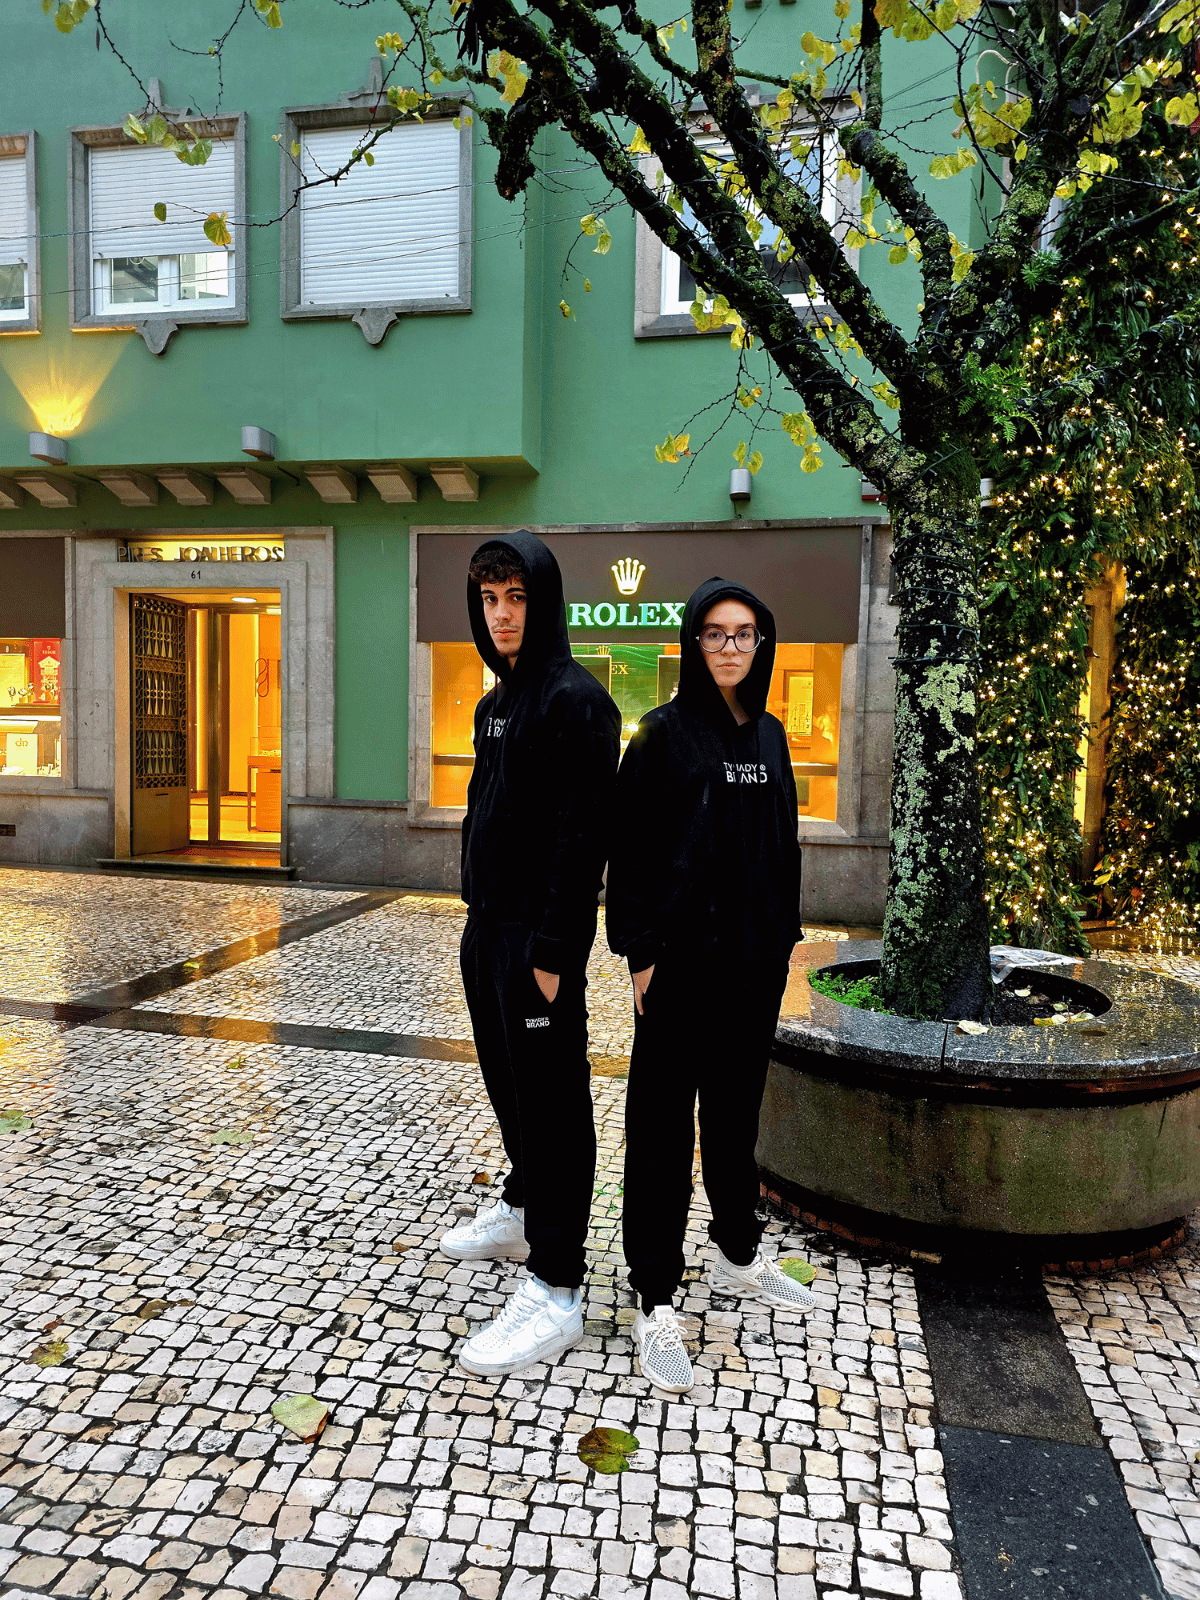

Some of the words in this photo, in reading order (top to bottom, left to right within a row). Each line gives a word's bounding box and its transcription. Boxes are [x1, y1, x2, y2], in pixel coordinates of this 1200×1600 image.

[190, 570, 201, 580] 61
[568, 602, 686, 626] ROLEX
[526, 1020, 551, 1029] BRAND
